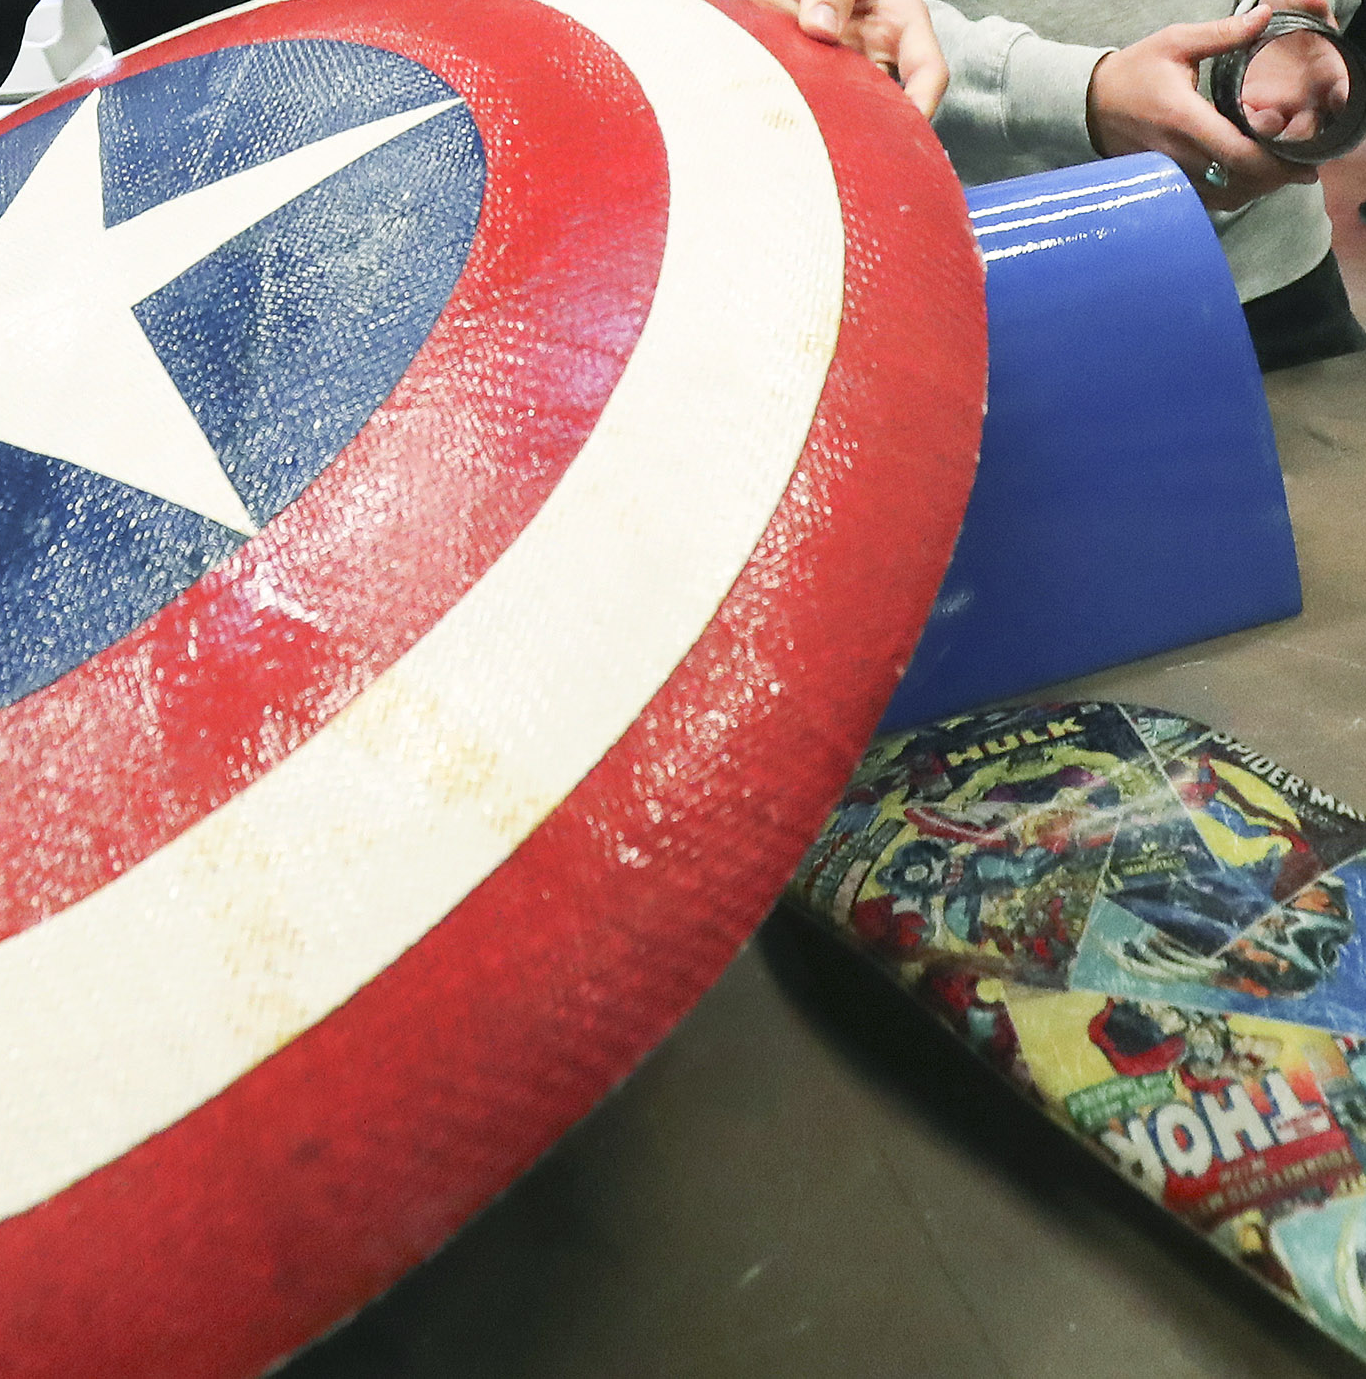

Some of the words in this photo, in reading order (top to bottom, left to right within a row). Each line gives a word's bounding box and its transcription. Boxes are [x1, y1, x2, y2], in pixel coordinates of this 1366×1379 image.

[946, 717, 1084, 767] HULK
[1213, 732, 1366, 822] SPIDER-MA
[1100, 1068, 1331, 1196] THOR
